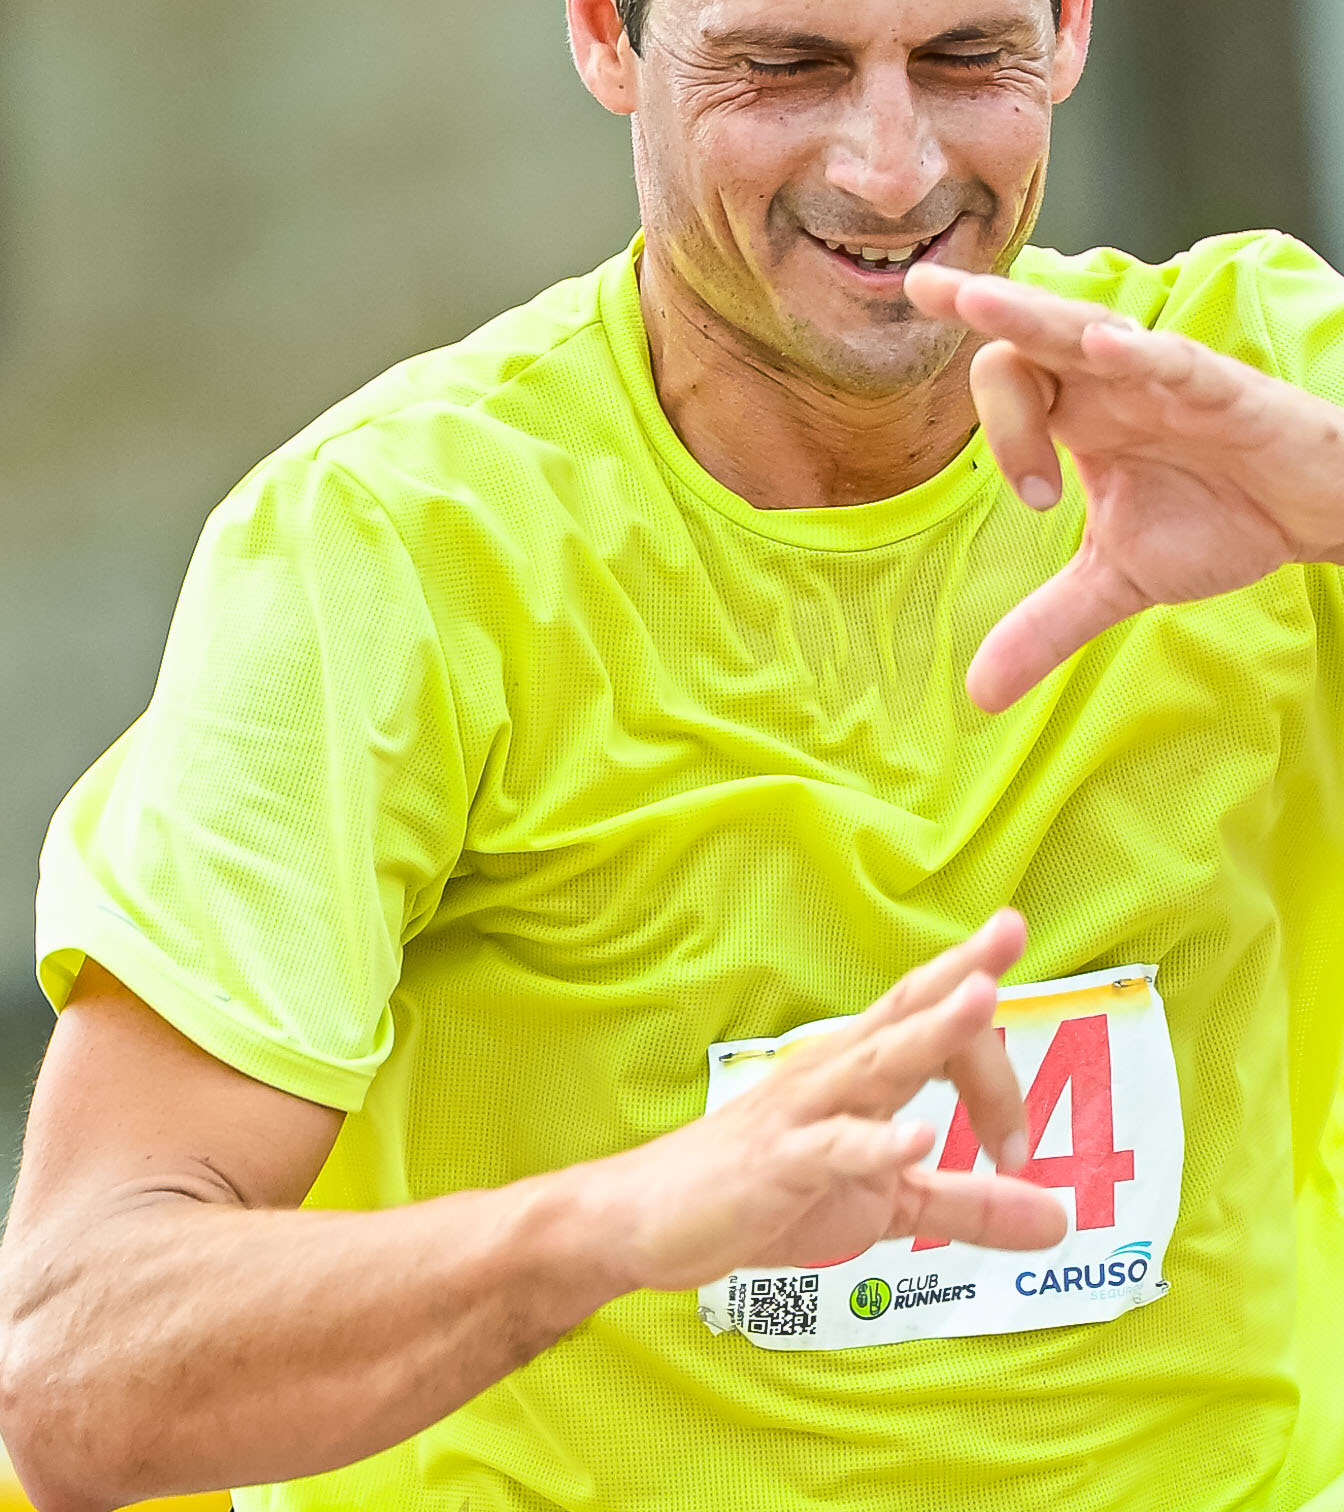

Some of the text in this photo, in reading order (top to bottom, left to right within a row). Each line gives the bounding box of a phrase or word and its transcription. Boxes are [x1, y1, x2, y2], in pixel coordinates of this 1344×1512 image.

[897, 1274, 939, 1294] CLUB
[1015, 1259, 1148, 1296] CARUSO
[893, 1284, 976, 1310] RUNNER'S
